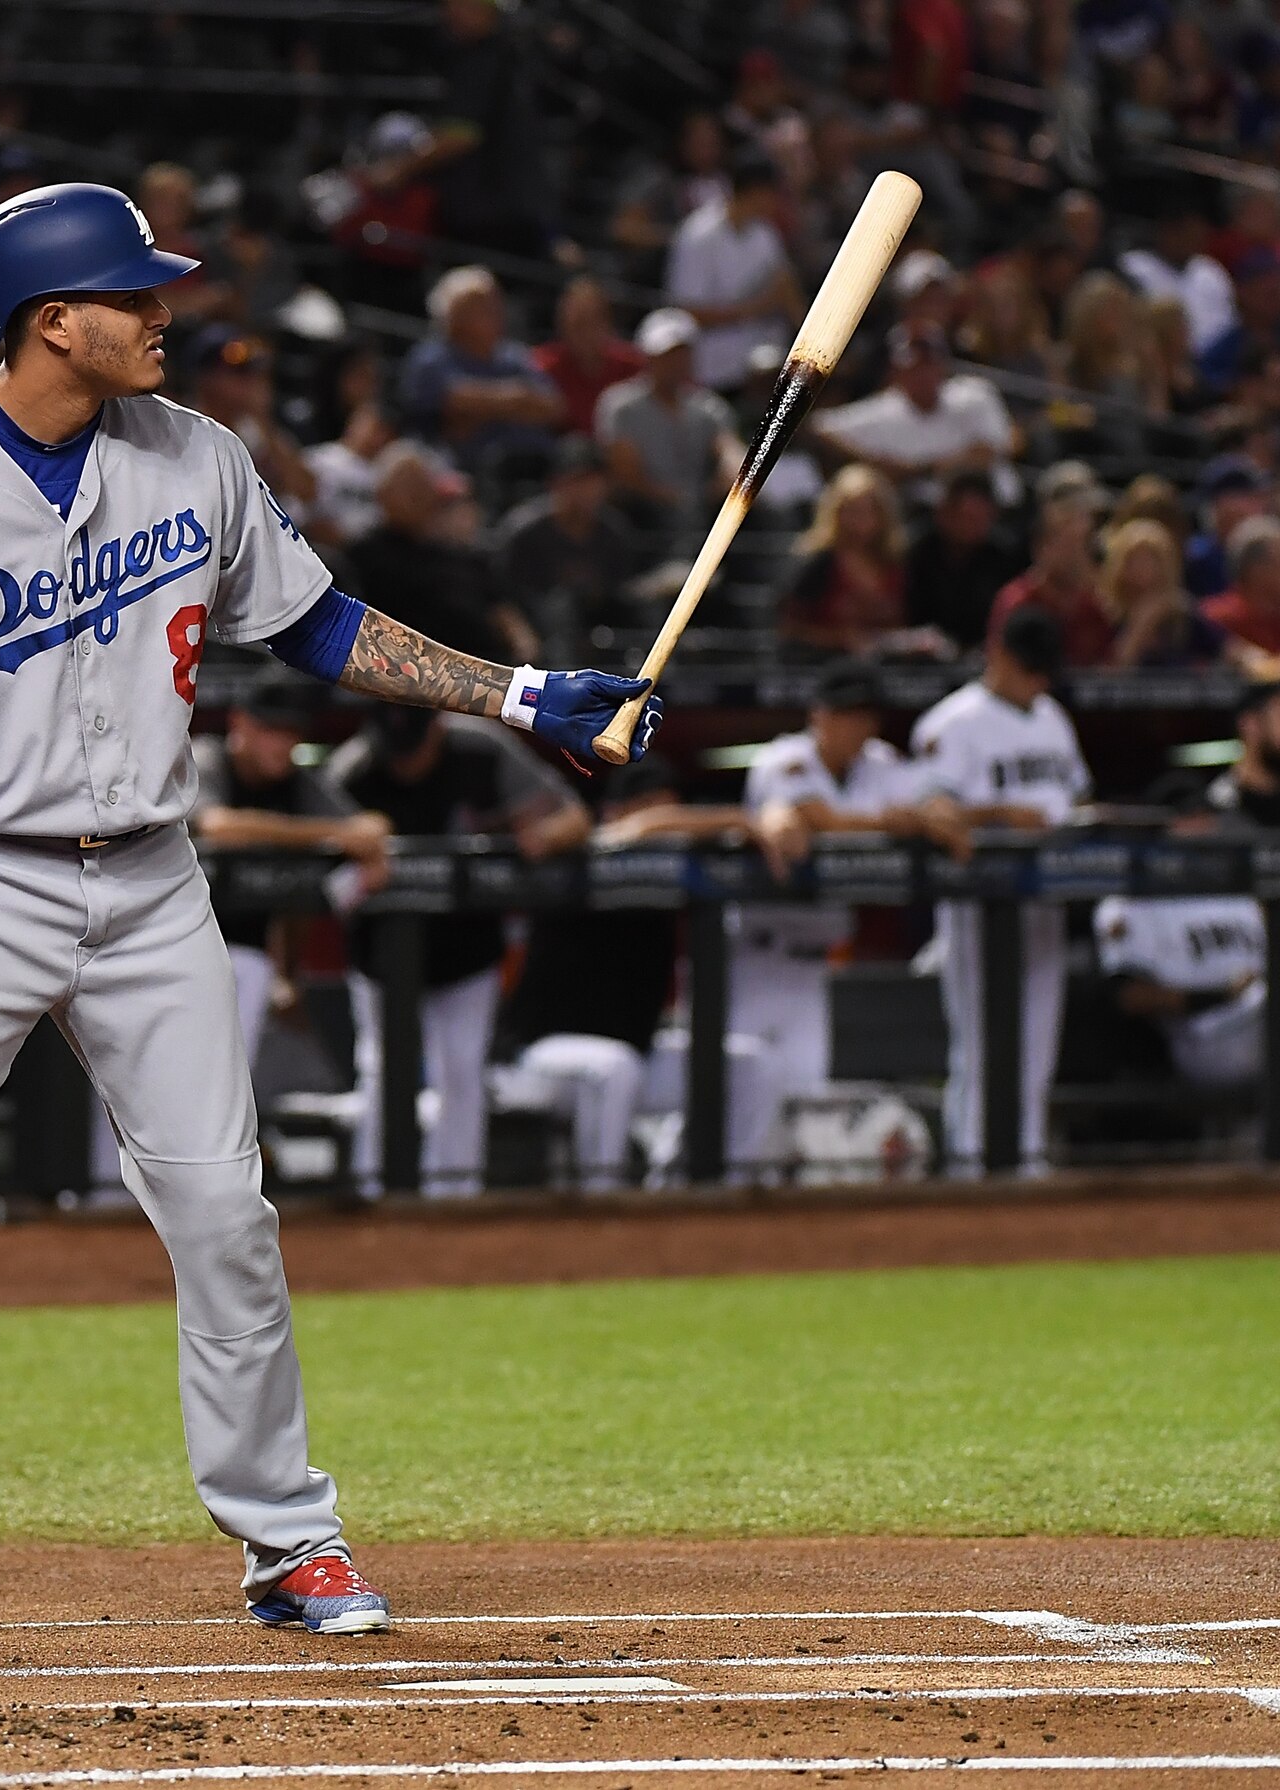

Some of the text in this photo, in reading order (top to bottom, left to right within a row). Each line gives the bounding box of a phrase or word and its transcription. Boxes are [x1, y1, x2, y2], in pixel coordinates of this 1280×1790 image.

[124, 200, 155, 246] LA
[166, 602, 207, 706] 8
[523, 691, 538, 701] 8
